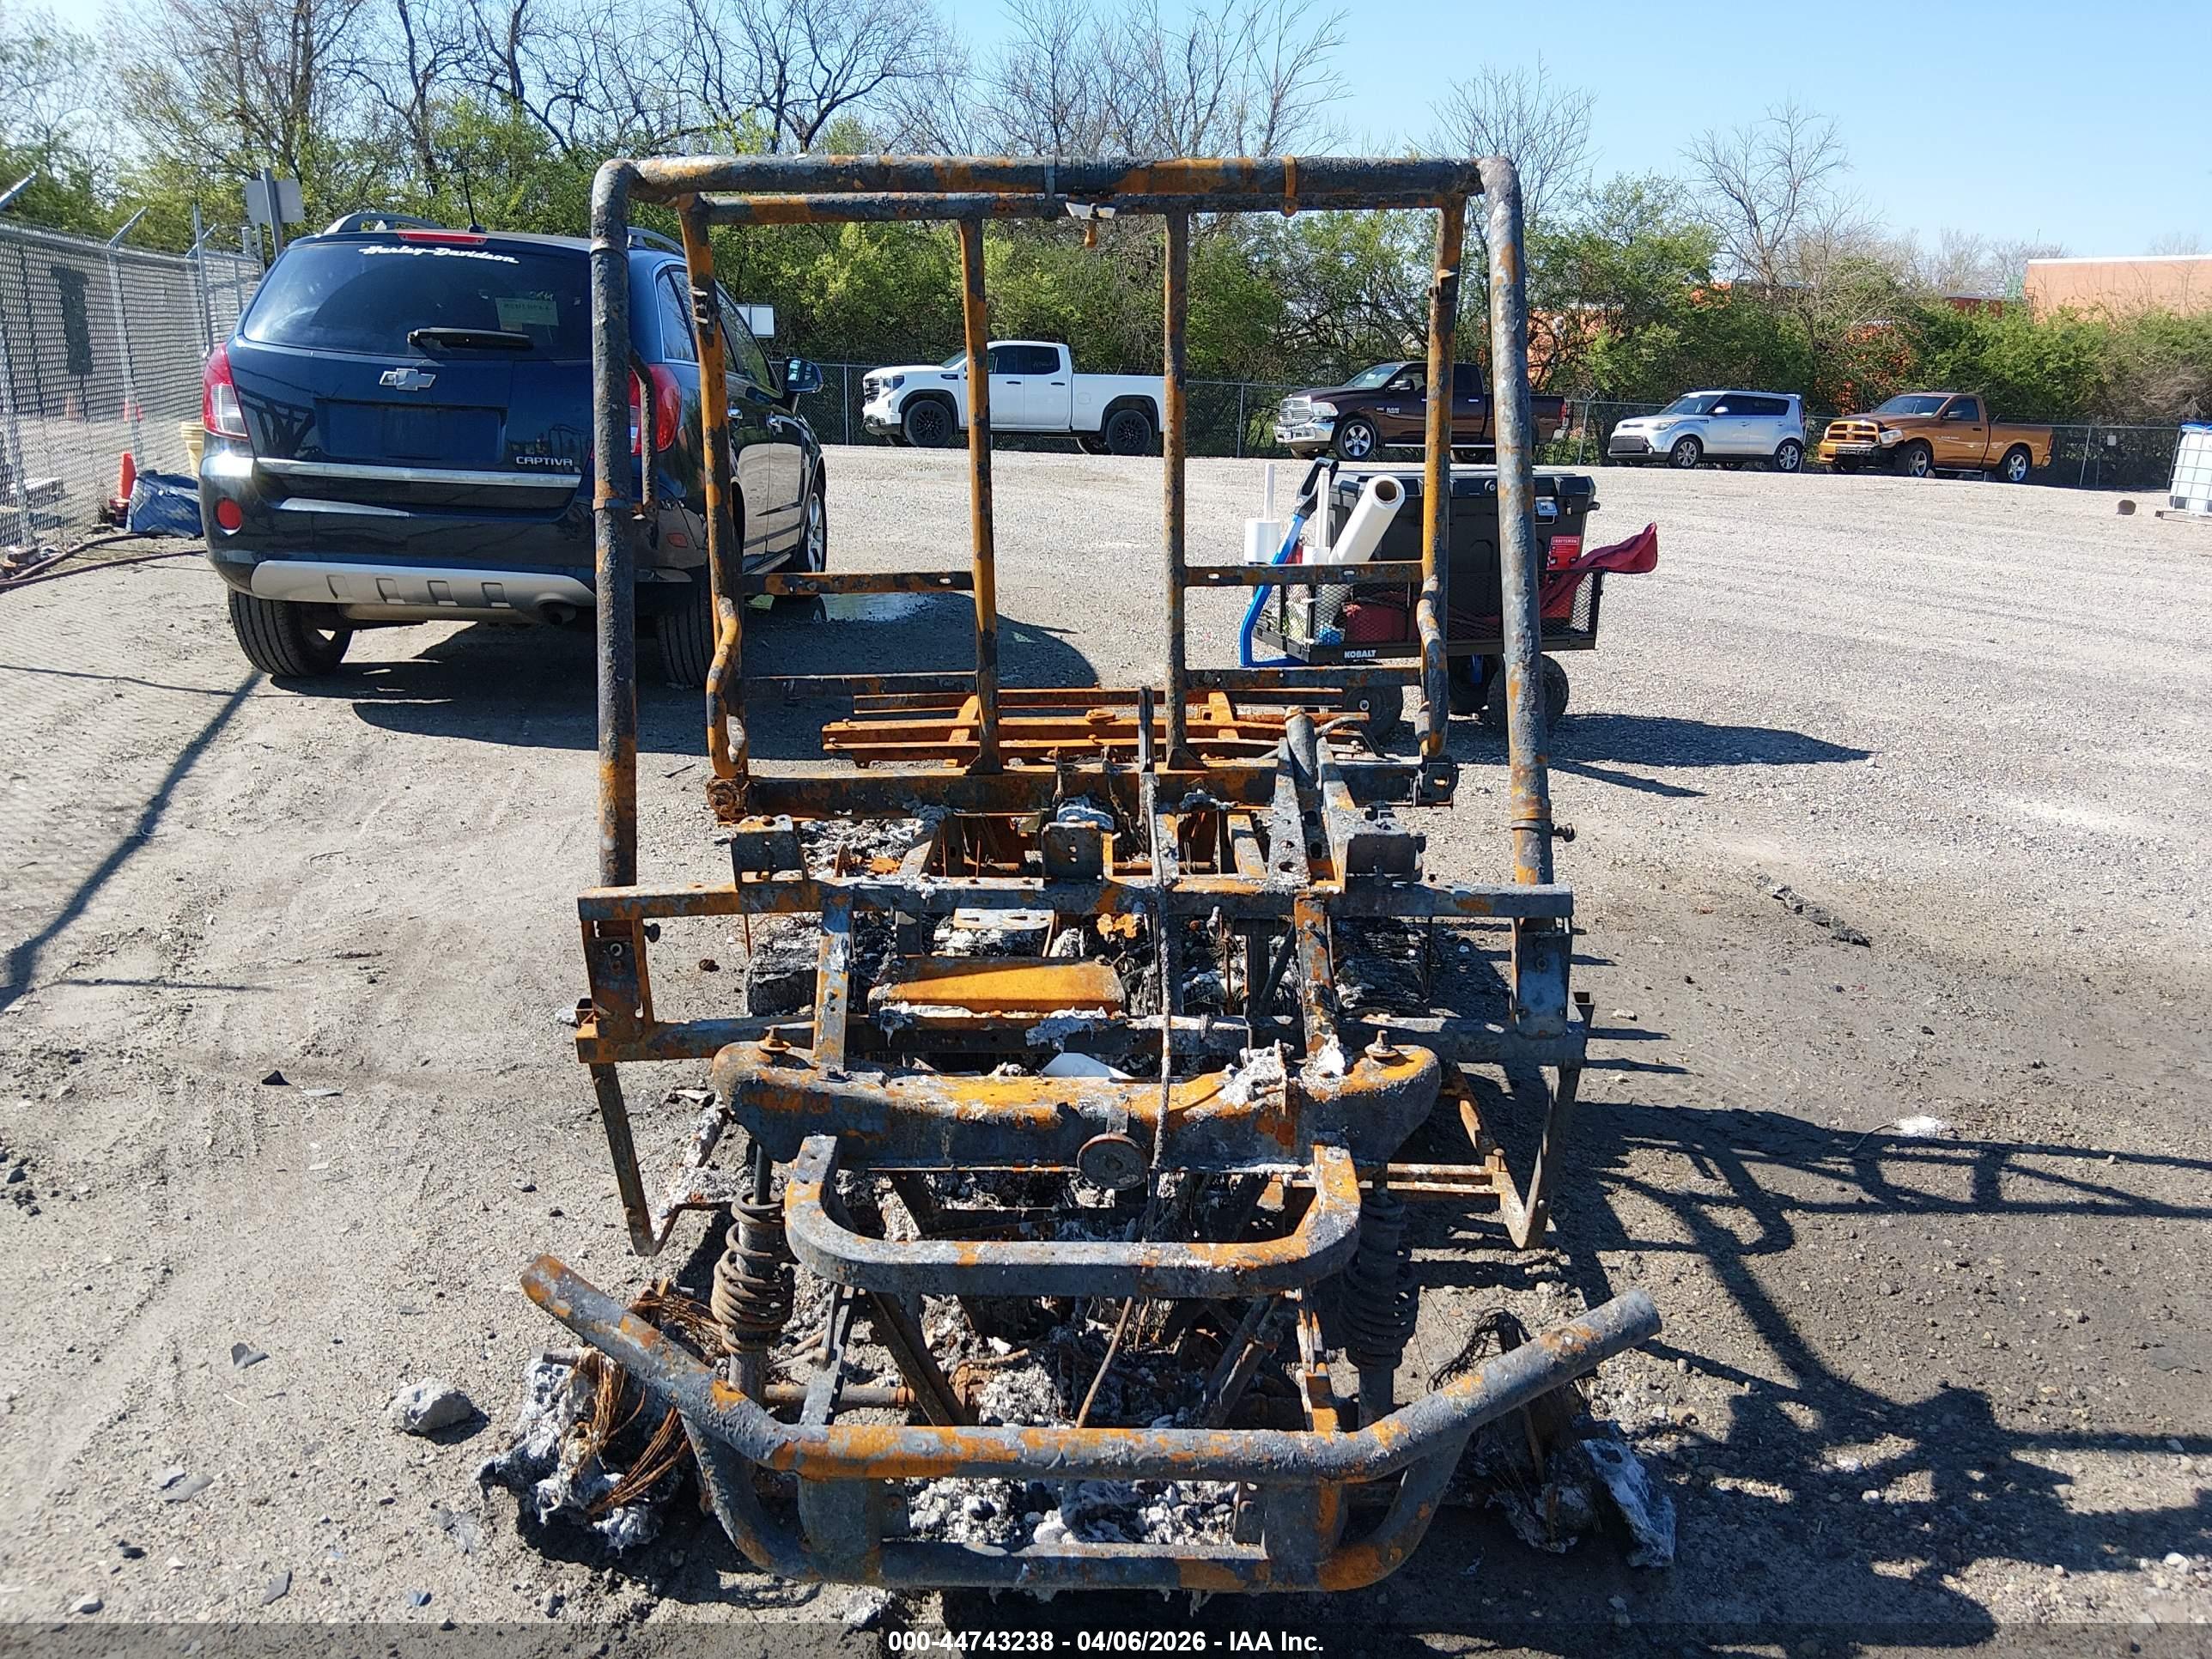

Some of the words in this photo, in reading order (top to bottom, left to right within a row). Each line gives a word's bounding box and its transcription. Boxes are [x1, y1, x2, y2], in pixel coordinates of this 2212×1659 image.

[358, 246, 520, 264] Harley-Davidson
[516, 456, 573, 466] CAPTIVA
[1344, 649, 1376, 659] KOBALT
